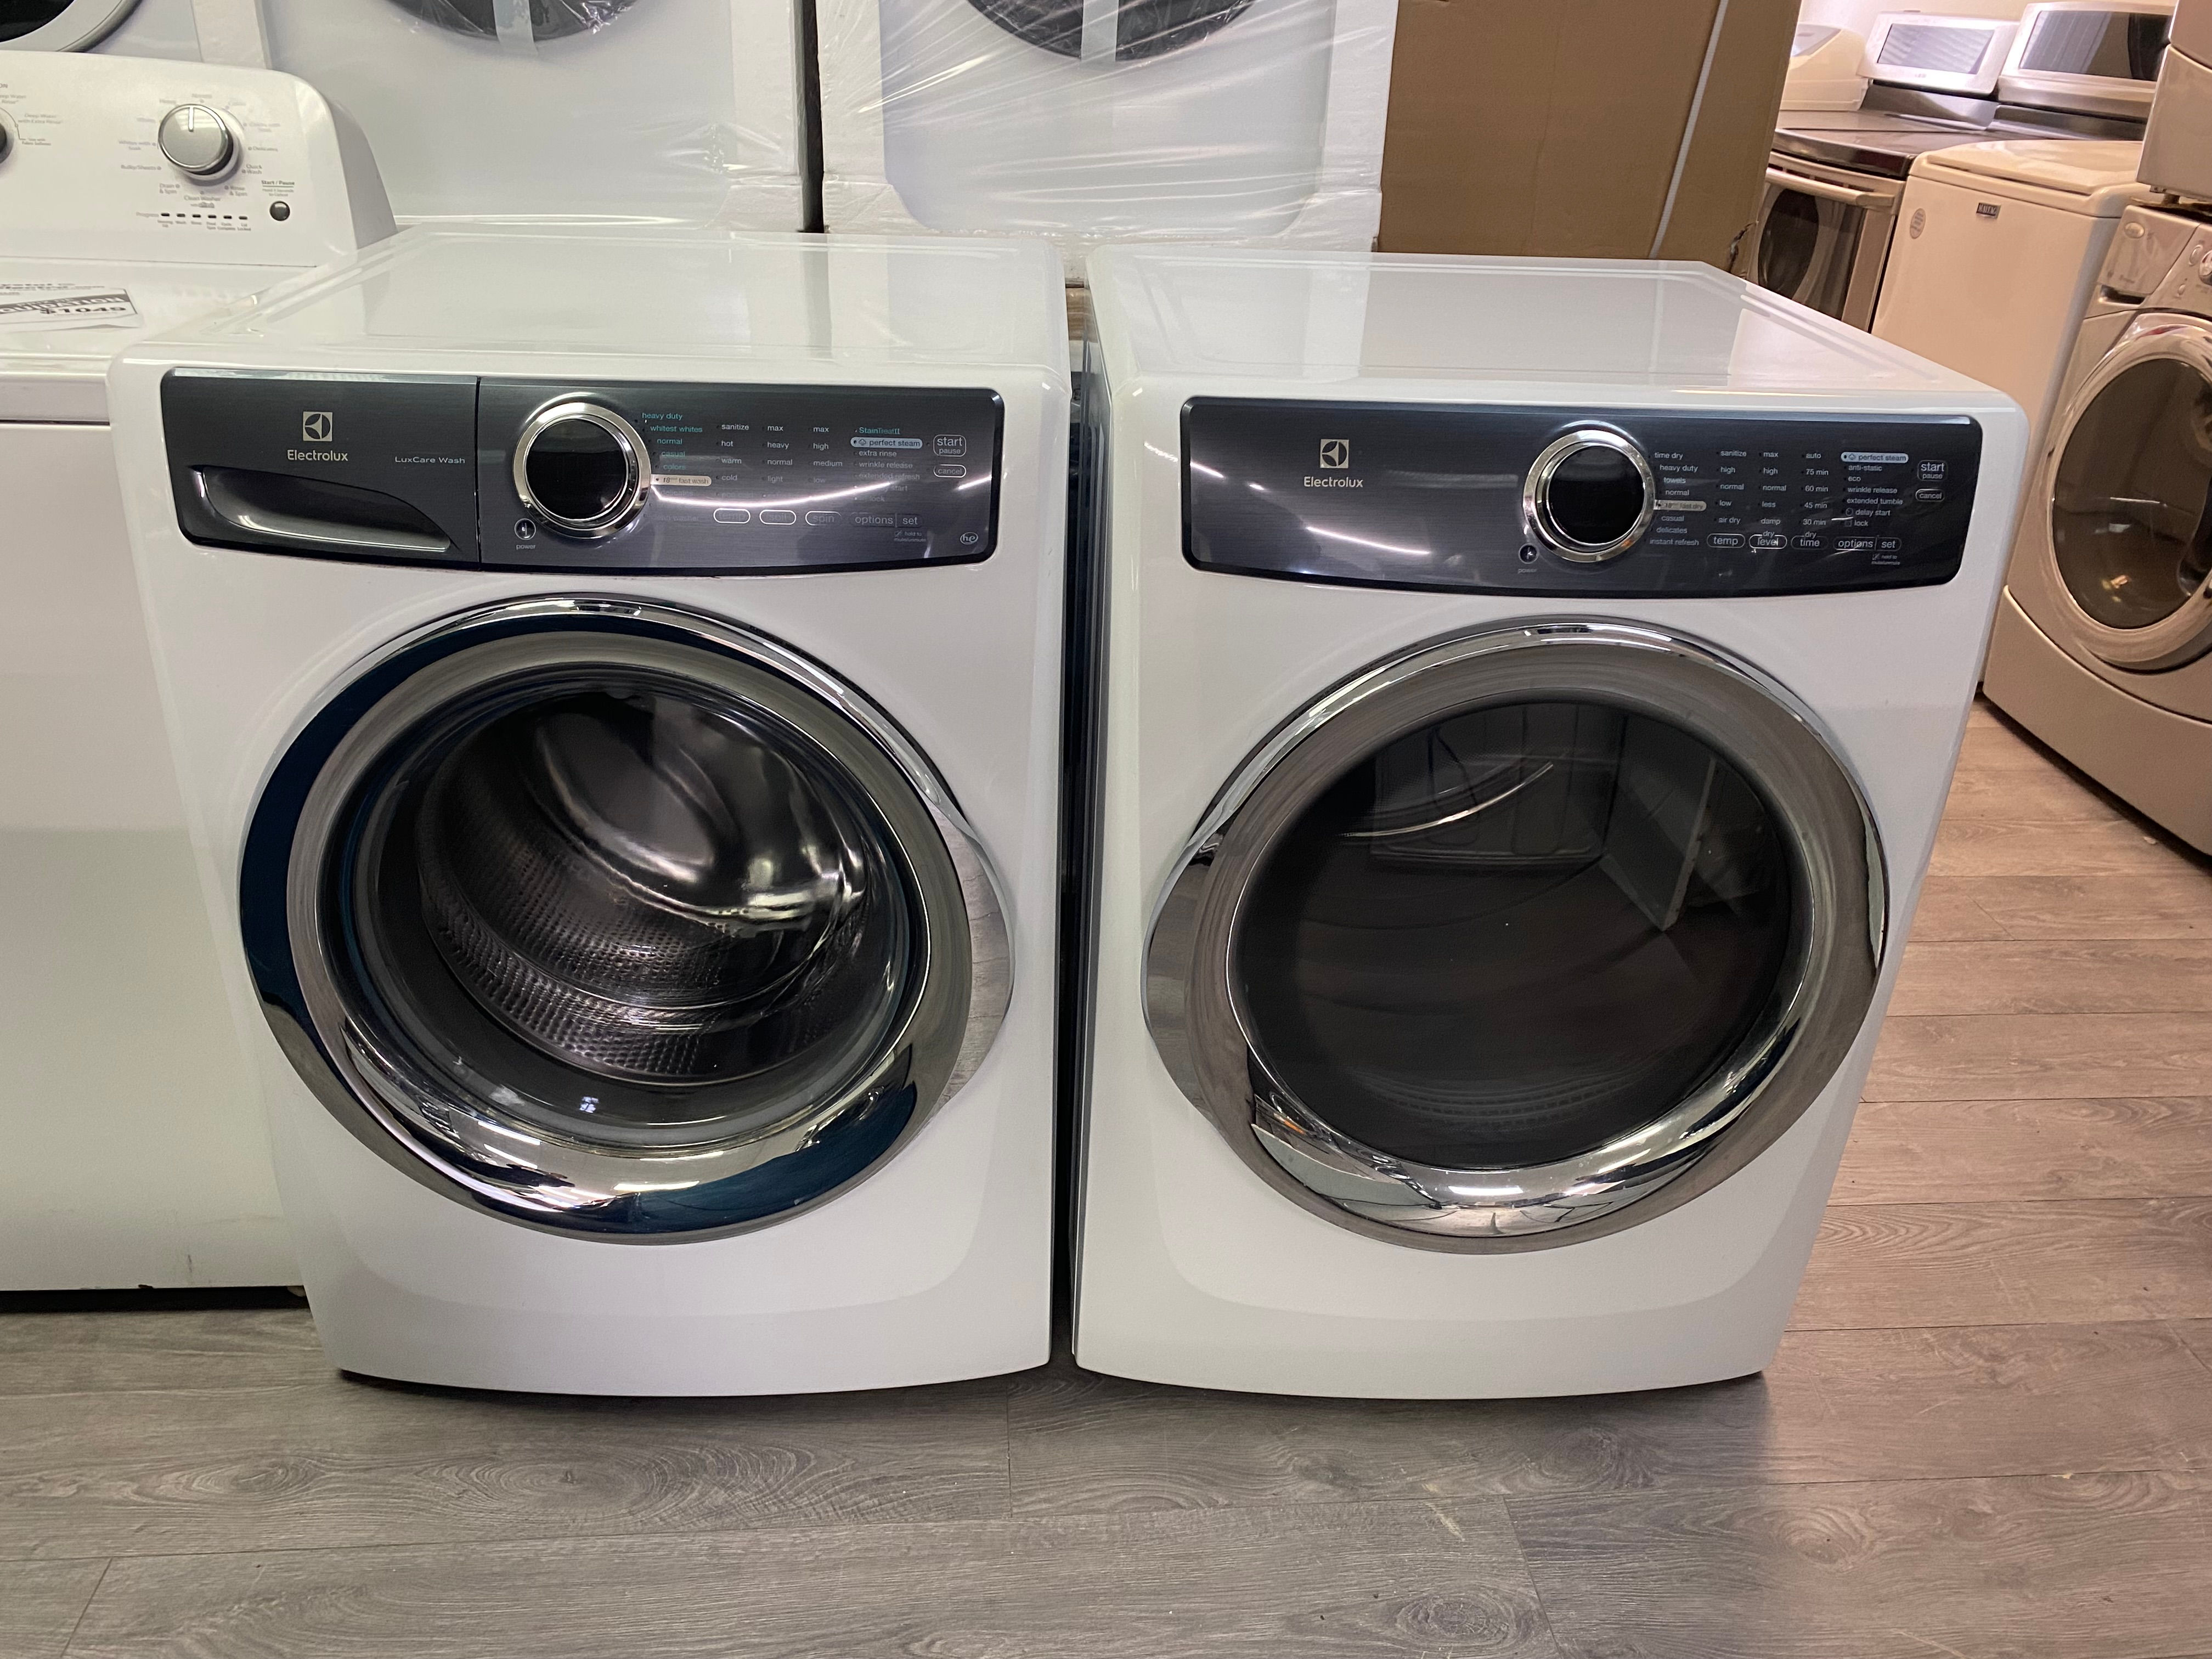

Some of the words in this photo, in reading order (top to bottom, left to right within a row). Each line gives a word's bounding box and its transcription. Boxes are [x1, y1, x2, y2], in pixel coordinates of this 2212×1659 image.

[666, 413, 683, 421] duty
[937, 437, 962, 447] start
[287, 449, 349, 461] Electrolux
[939, 448, 961, 456] pause
[1672, 452, 1683, 460] dry
[1921, 462, 1945, 472] start
[1304, 476, 1364, 488] Electrolux
[813, 514, 834, 523] spin
[855, 516, 894, 525] options
[902, 516, 918, 525] set
[1713, 537, 1739, 546] temp
[1838, 539, 1874, 549] options
[1881, 540, 1896, 549] set
